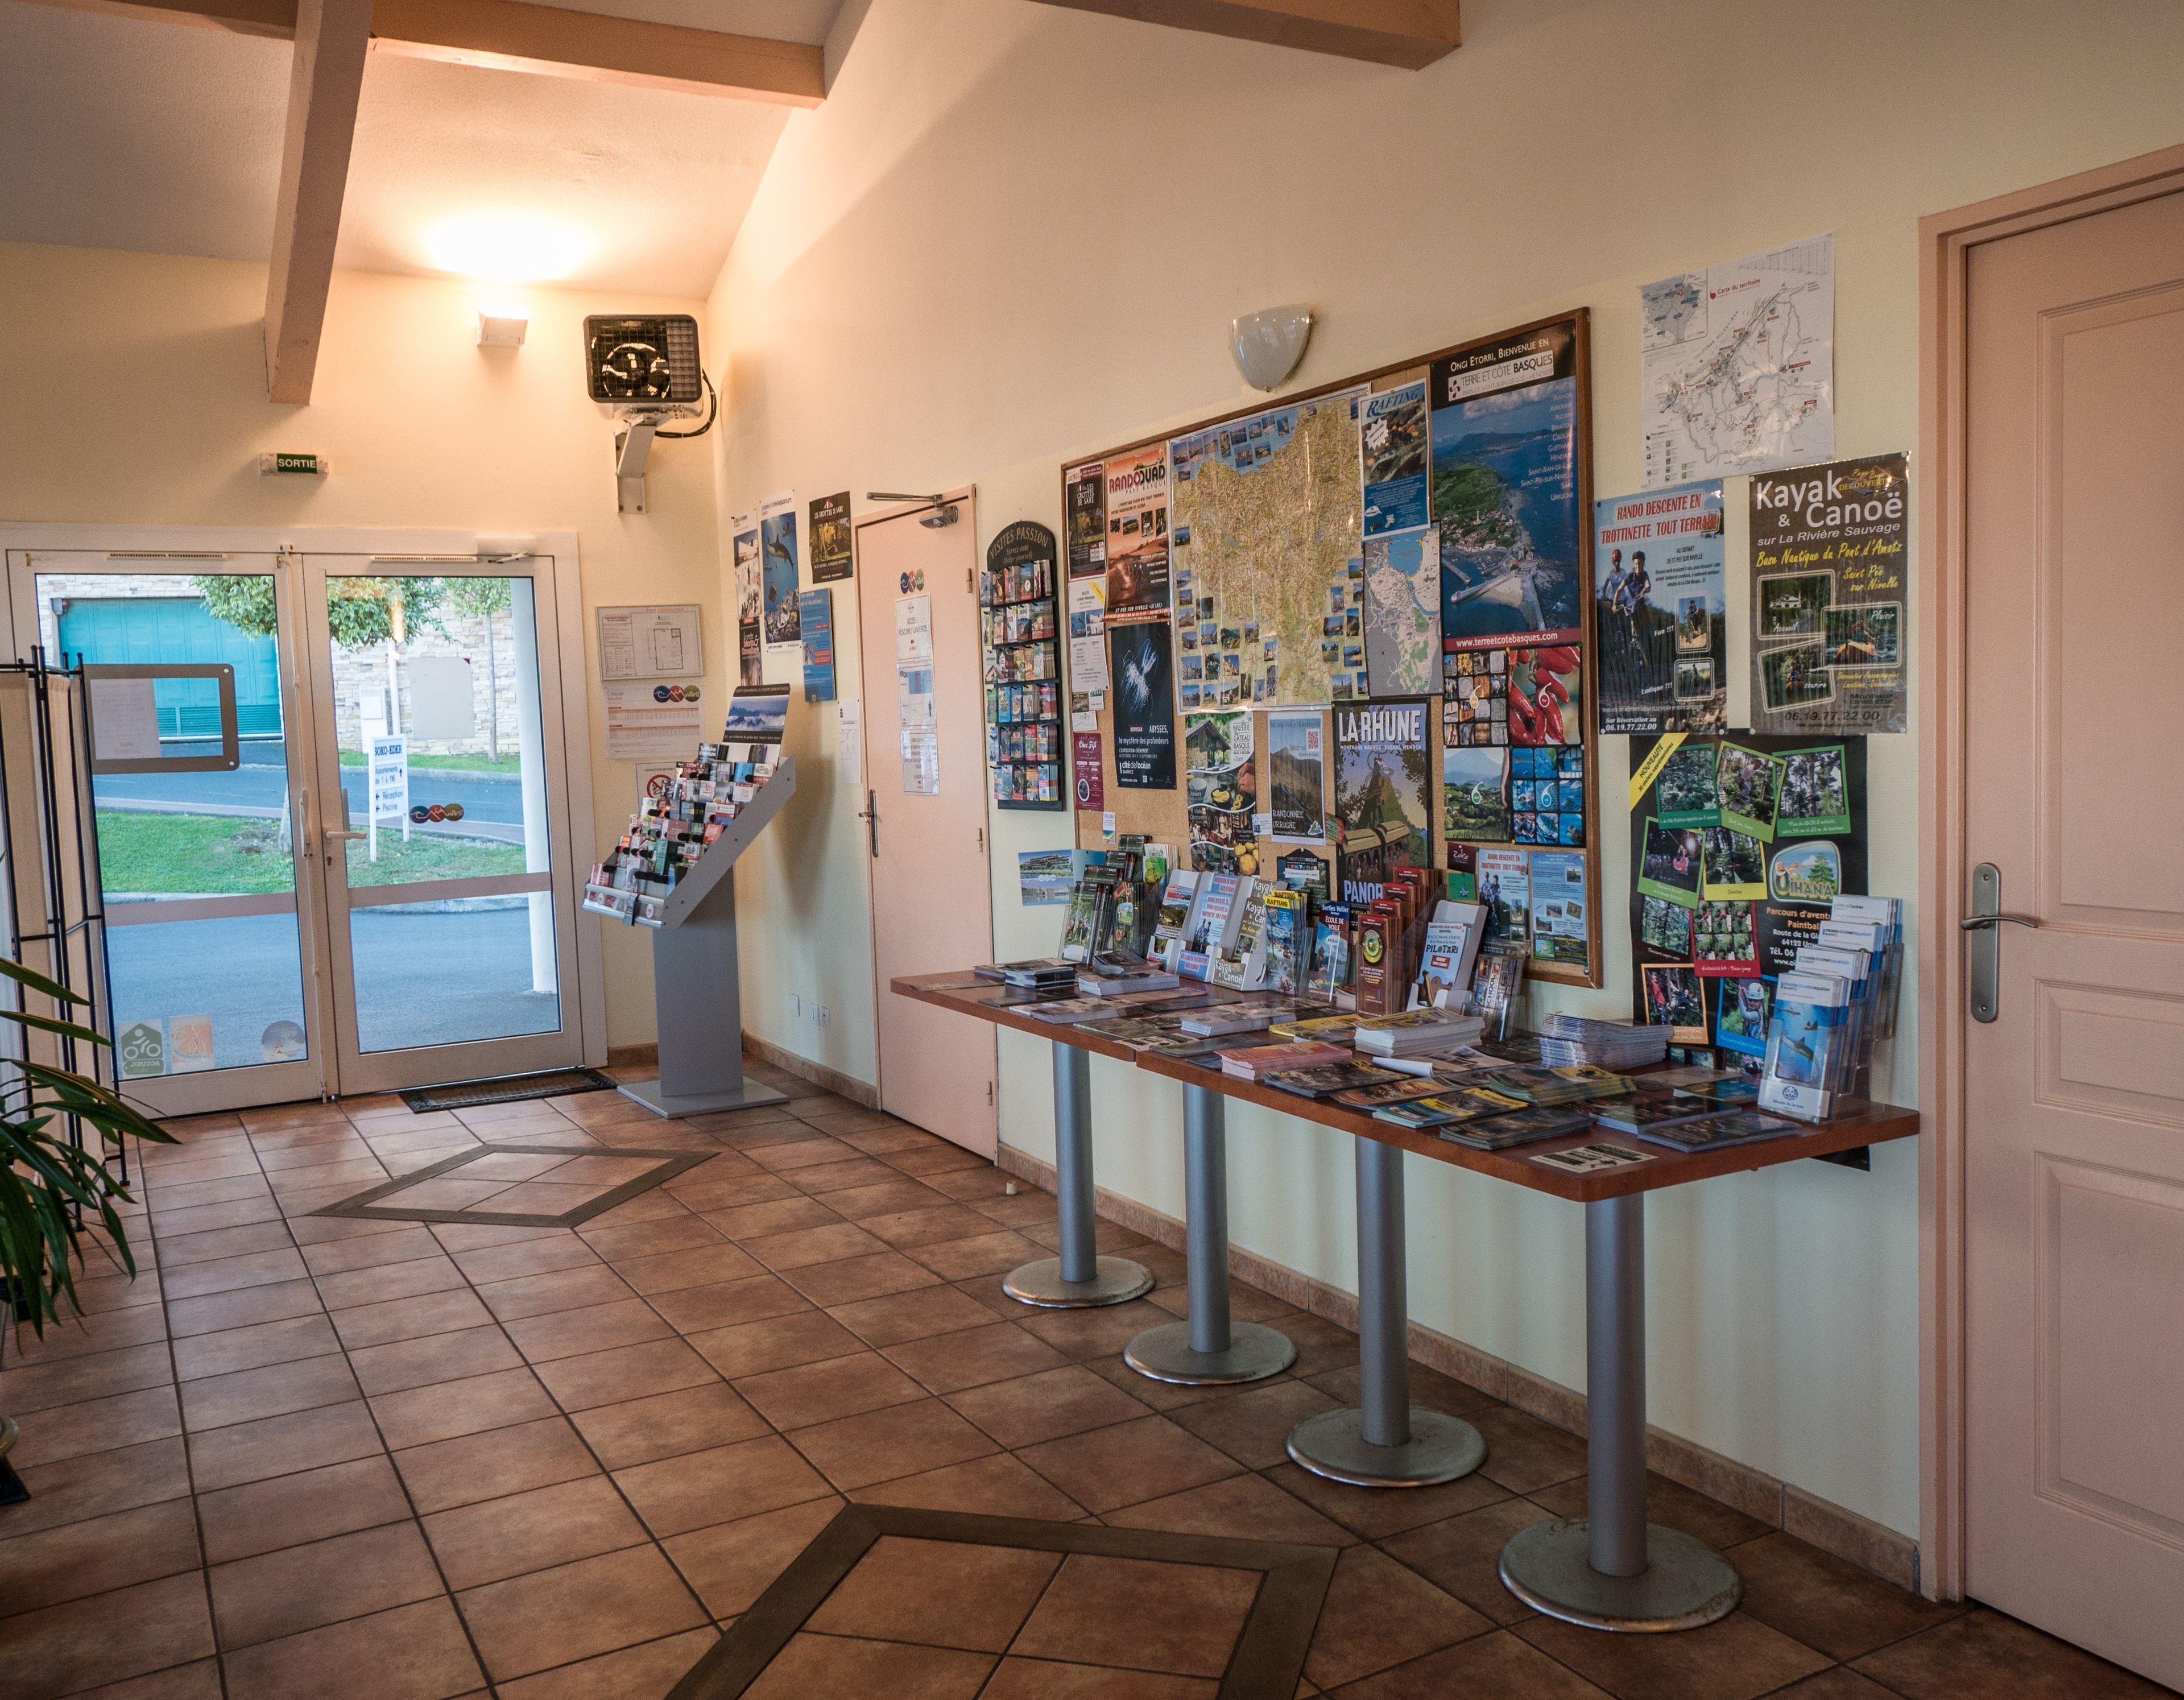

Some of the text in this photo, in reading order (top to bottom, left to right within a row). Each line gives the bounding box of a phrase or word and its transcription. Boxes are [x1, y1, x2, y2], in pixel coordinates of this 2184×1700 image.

[1717, 278, 1760, 295] Carte du territoire
[1538, 338, 1549, 348] EN
[1461, 353, 1553, 387] TERRE ET CÔTE BASQUES
[1529, 368, 1554, 379] HENDAYE
[1367, 387, 1420, 419] RAFTING
[278, 458, 316, 469] SORTIE
[1839, 478, 1891, 491] DECOUVERT
[1077, 490, 1094, 501] GROTTES
[1550, 491, 1574, 501] URRUGNE
[1756, 470, 1843, 512] Kayak
[1083, 496, 1094, 506] SARE
[1617, 493, 1702, 520] RANDO DESCENTE EN
[1778, 491, 1902, 528] & Canoë
[1601, 512, 1718, 544] TROTTINETTE TOUT TERRAIN
[1757, 522, 1901, 547] sur La Rivière Sauvage
[990, 527, 1049, 560] VISITES PASSION
[1756, 550, 1777, 568] Base
[1780, 547, 1820, 568] Nautique
[1822, 545, 1834, 560] du
[1838, 542, 1860, 559] Pont
[1843, 564, 1885, 580] Saint Pée
[1850, 576, 1898, 592] sur Nivelle
[1871, 609, 1896, 621] Plaisir
[1773, 621, 1798, 633] Accueil
[1456, 632, 1558, 648] www.terreetcotebasques.com
[1641, 684, 1664, 694] Ludique
[1784, 711, 1880, 721] 06.19.77.2200
[1338, 710, 1422, 742] LA RHUNE
[1606, 723, 1657, 731] 06.19.77.22.00
[1123, 737, 1139, 746] mystère
[1147, 737, 1169, 746] profondeurs
[374, 744, 402, 756] SOKO-EDER
[1639, 742, 1664, 779] NOUVEAUTÉ
[382, 790, 404, 801] Réception
[1246, 900, 1266, 915] Kayak
[1267, 899, 1288, 908] RAFTING
[1321, 904, 1336, 912] Sorties
[1766, 907, 1798, 917] Parcours
[1781, 938, 1802, 947] 64122
[1769, 947, 1784, 956] Tél.
[1215, 959, 1232, 973] Kayak
